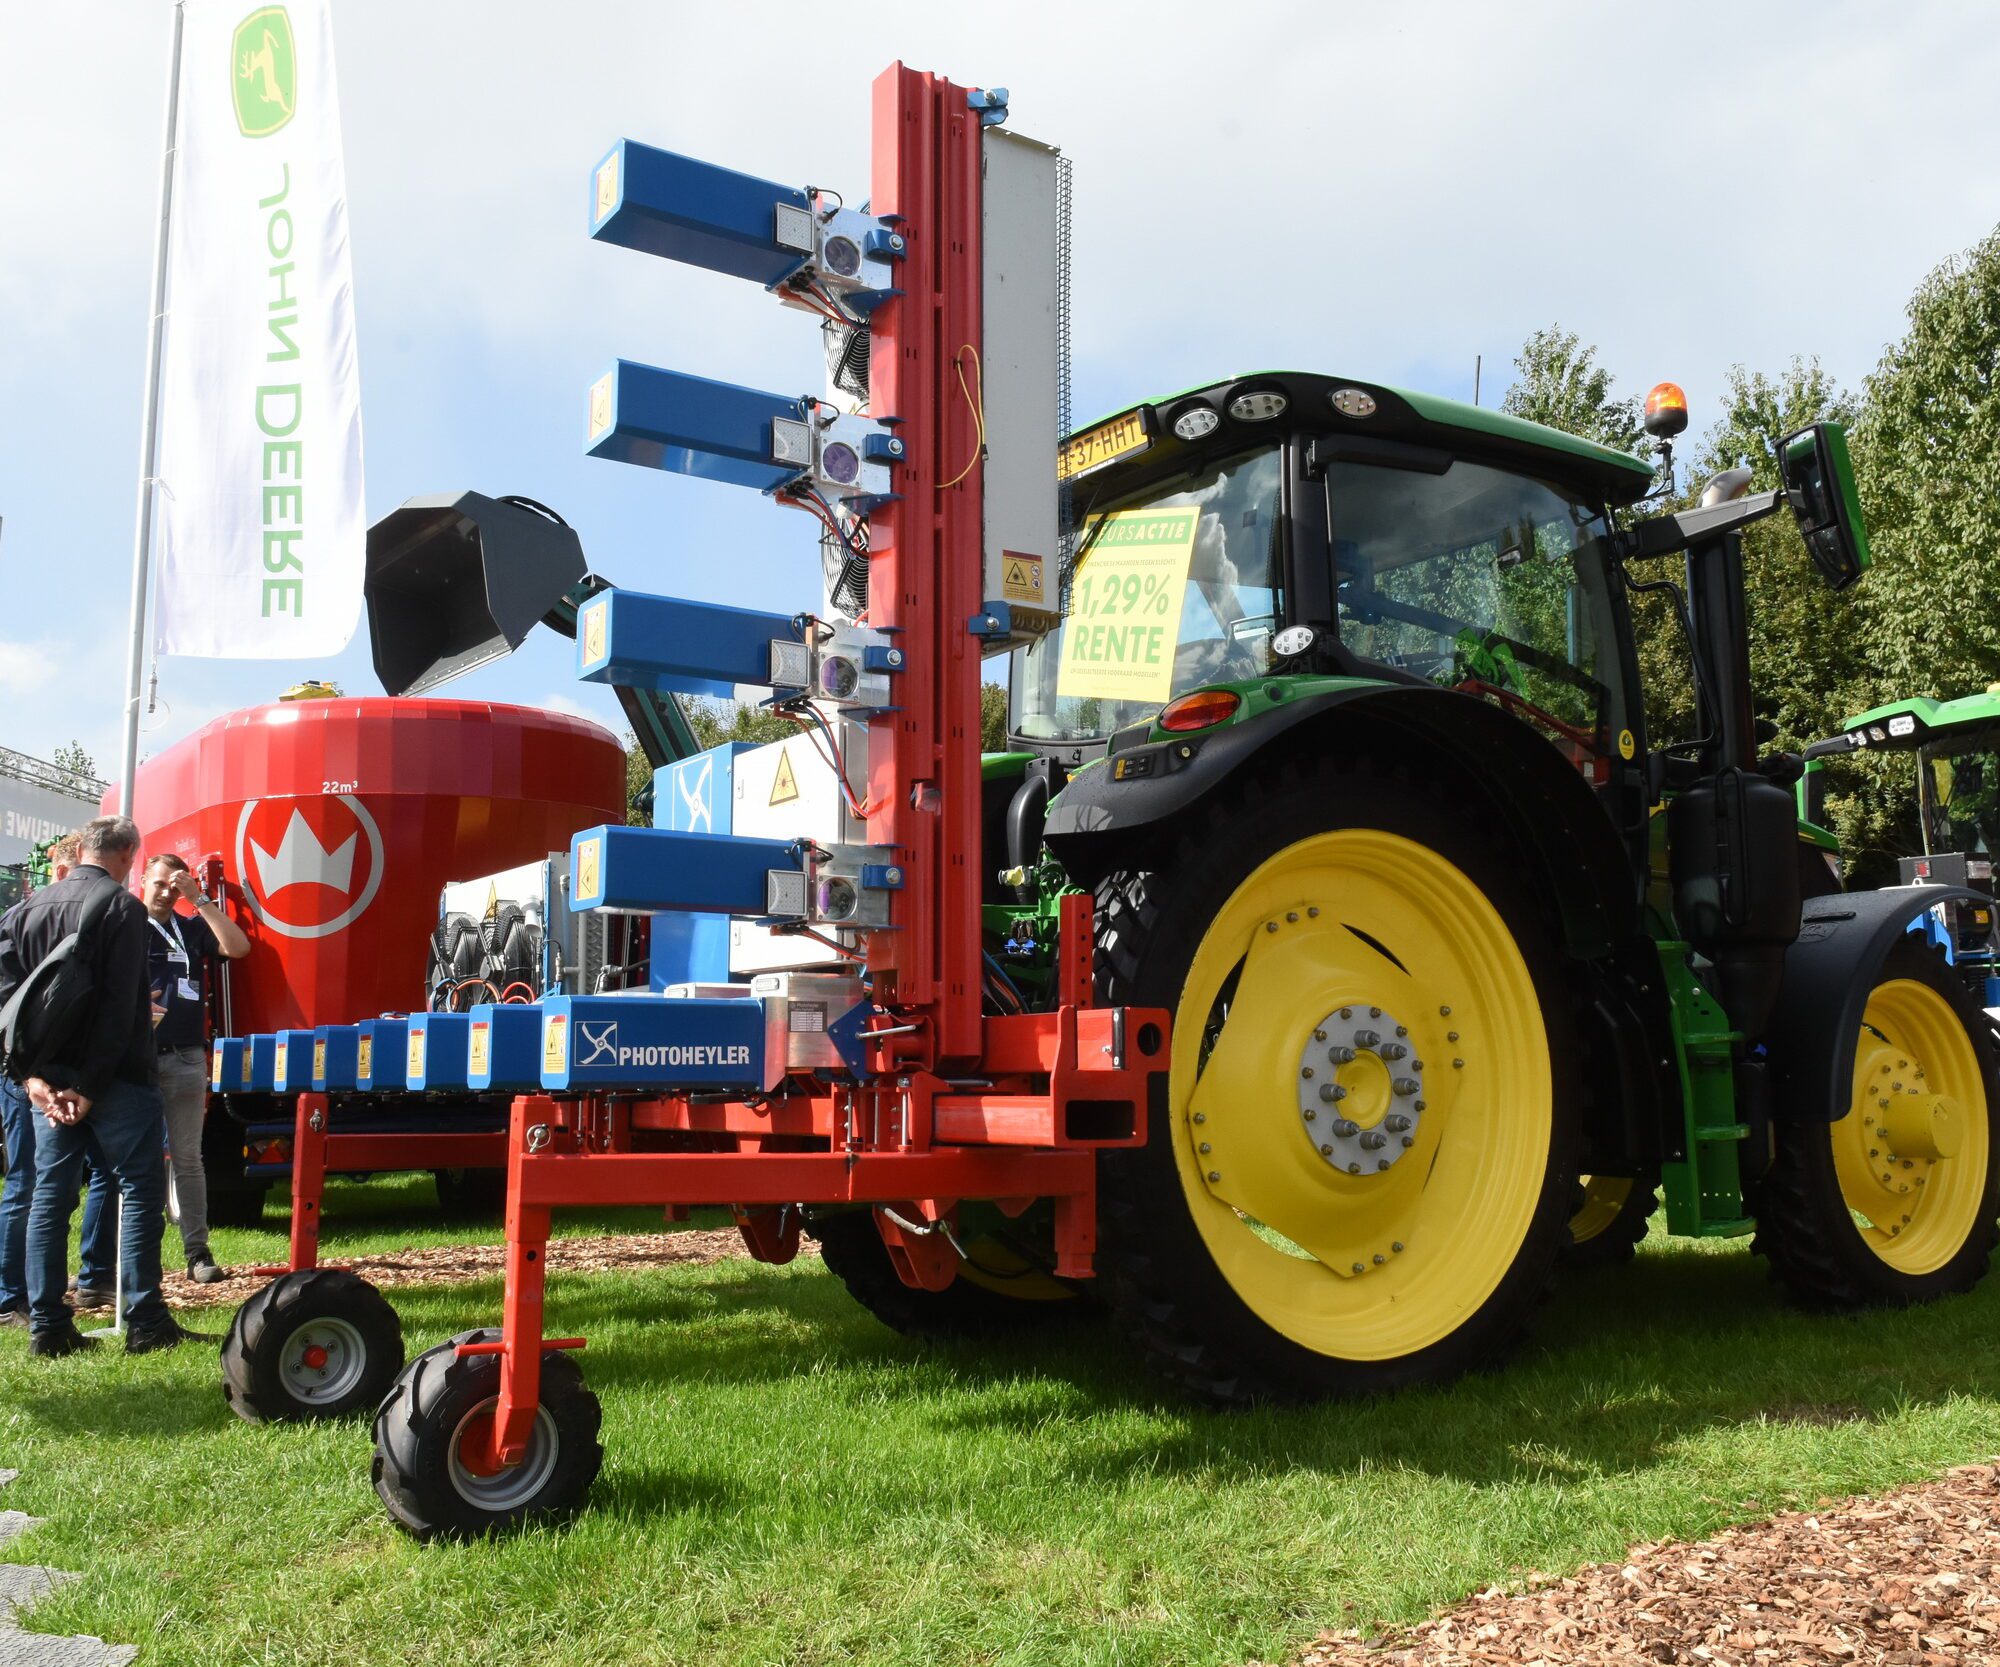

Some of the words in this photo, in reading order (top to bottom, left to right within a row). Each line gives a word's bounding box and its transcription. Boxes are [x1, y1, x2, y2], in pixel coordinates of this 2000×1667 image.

[1096, 521, 1186, 542] EURSACTIE
[1081, 573, 1171, 618] 1,29%
[1072, 625, 1164, 664] RENTE
[619, 1045, 750, 1066] PHOTOHEYLER
